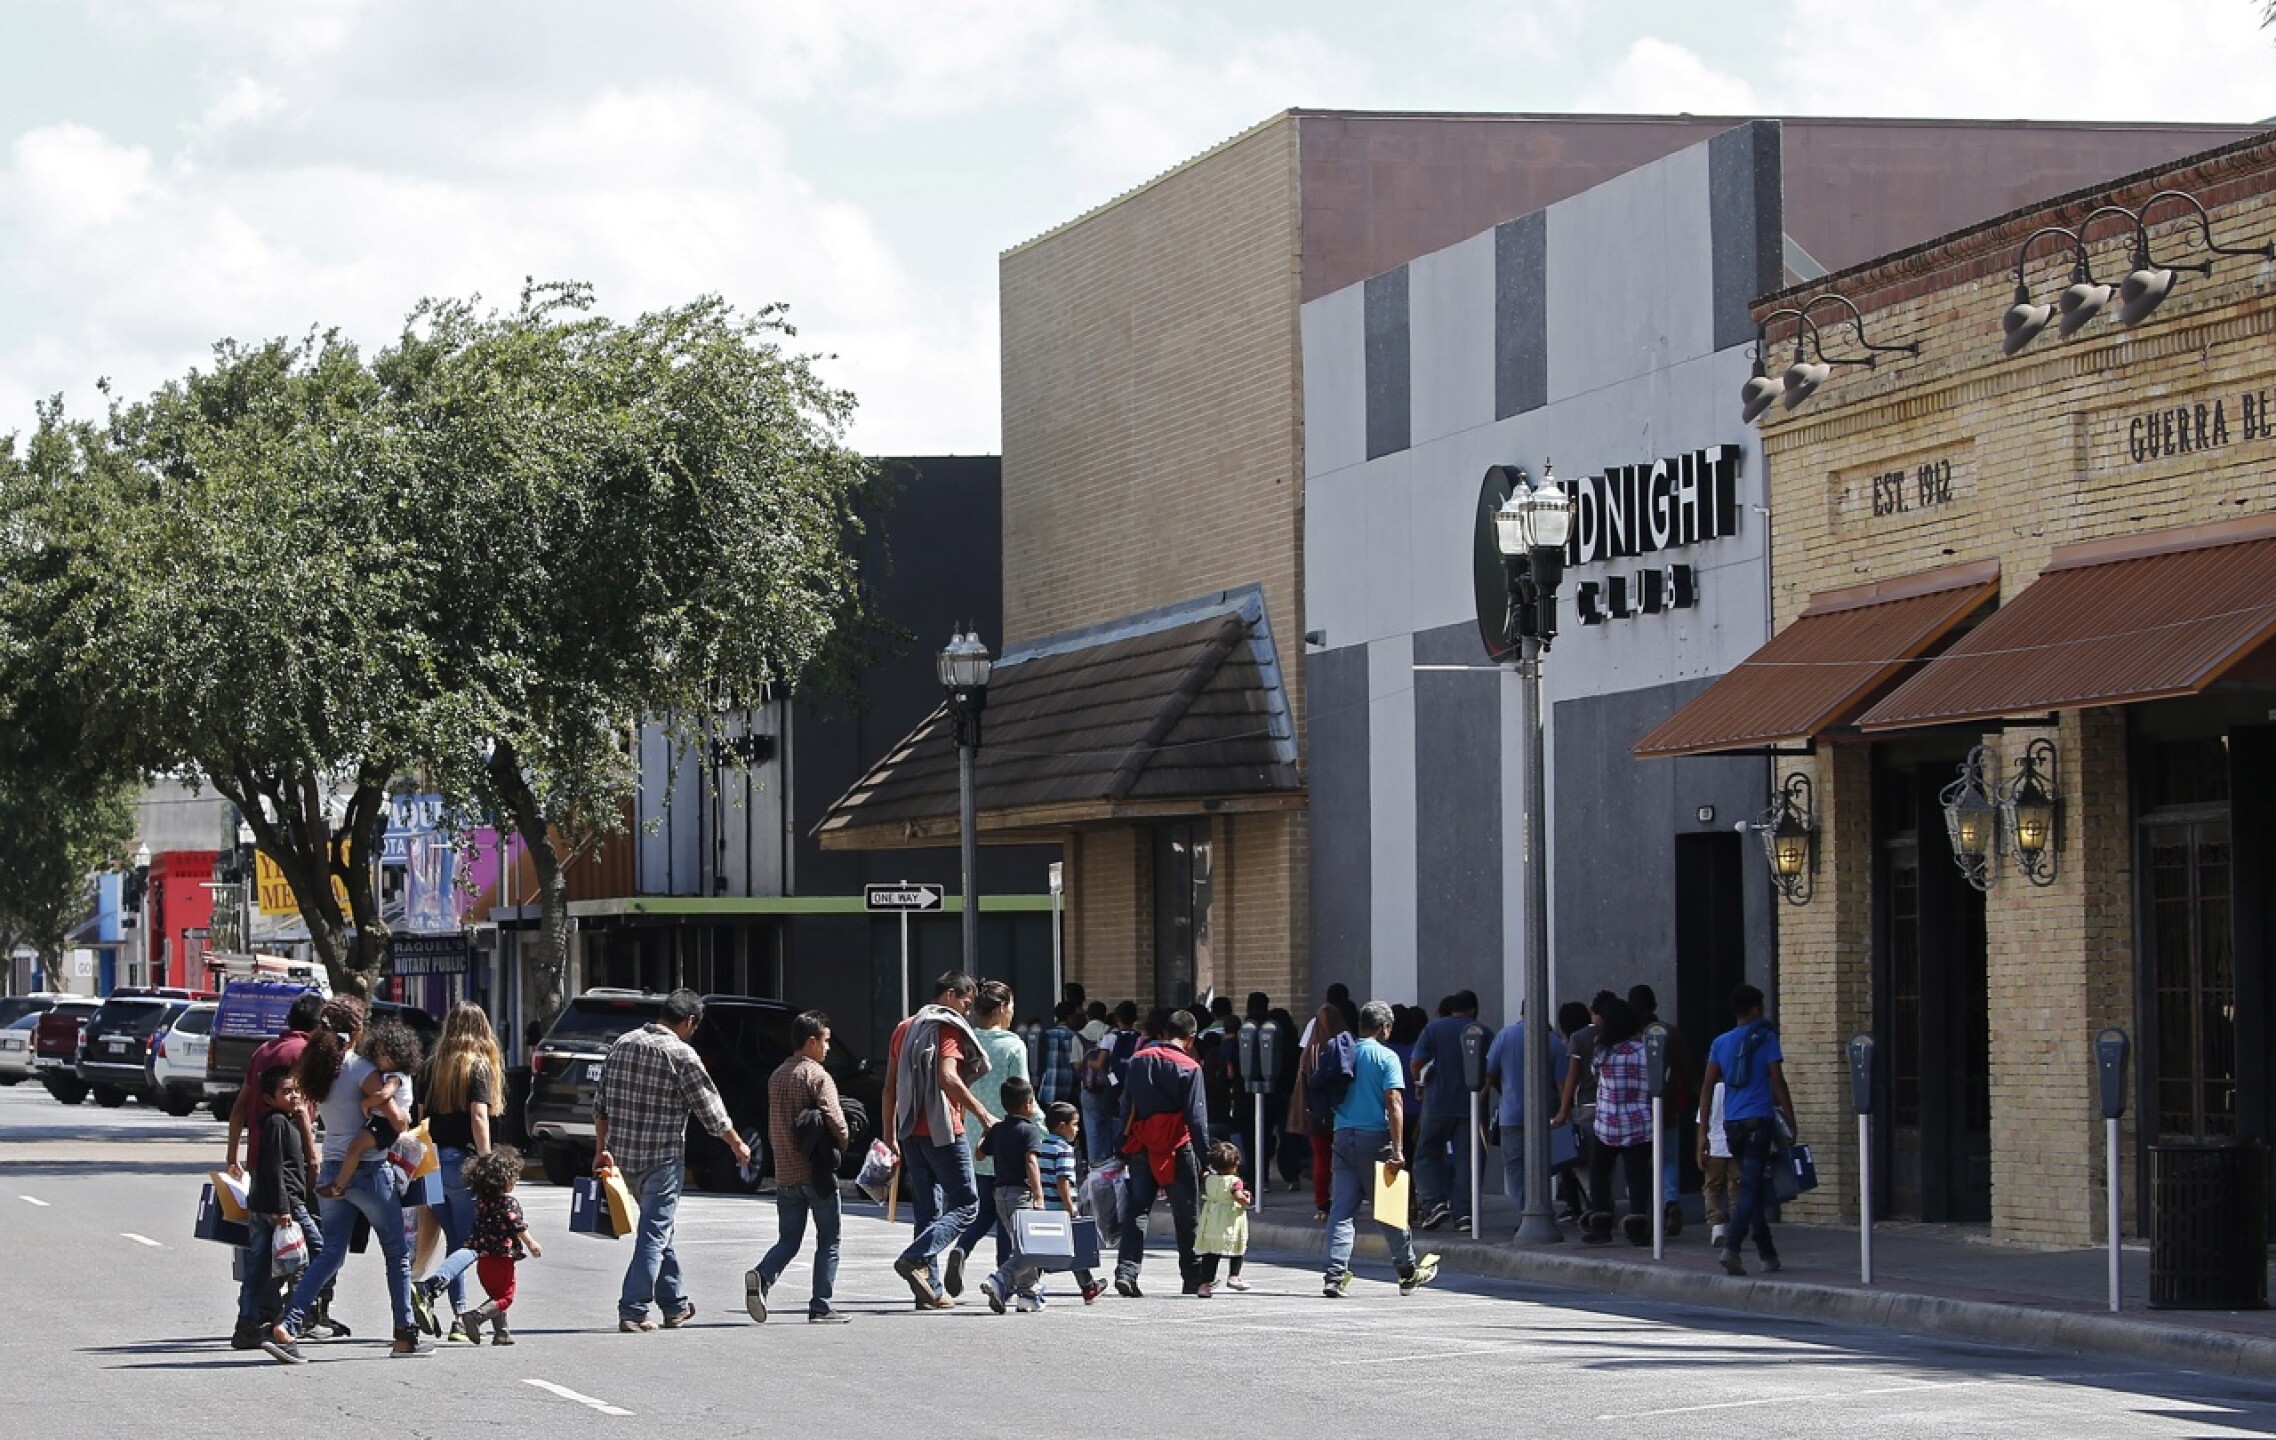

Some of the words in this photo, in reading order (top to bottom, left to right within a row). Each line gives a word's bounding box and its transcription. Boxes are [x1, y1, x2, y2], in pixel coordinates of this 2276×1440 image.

[2129, 399, 2230, 464] GUERRA
[1564, 444, 1740, 566] DNIGHT
[1873, 470, 1909, 518] EST.
[1918, 458, 1953, 507] 1912
[1576, 564, 1694, 625] CLUB
[874, 893, 894, 903] ONE
[898, 893, 918, 903] WAY
[393, 940, 465, 954] RAQUEL'S
[393, 956, 430, 975] NOTARY
[431, 955, 467, 974] PUBLIC
